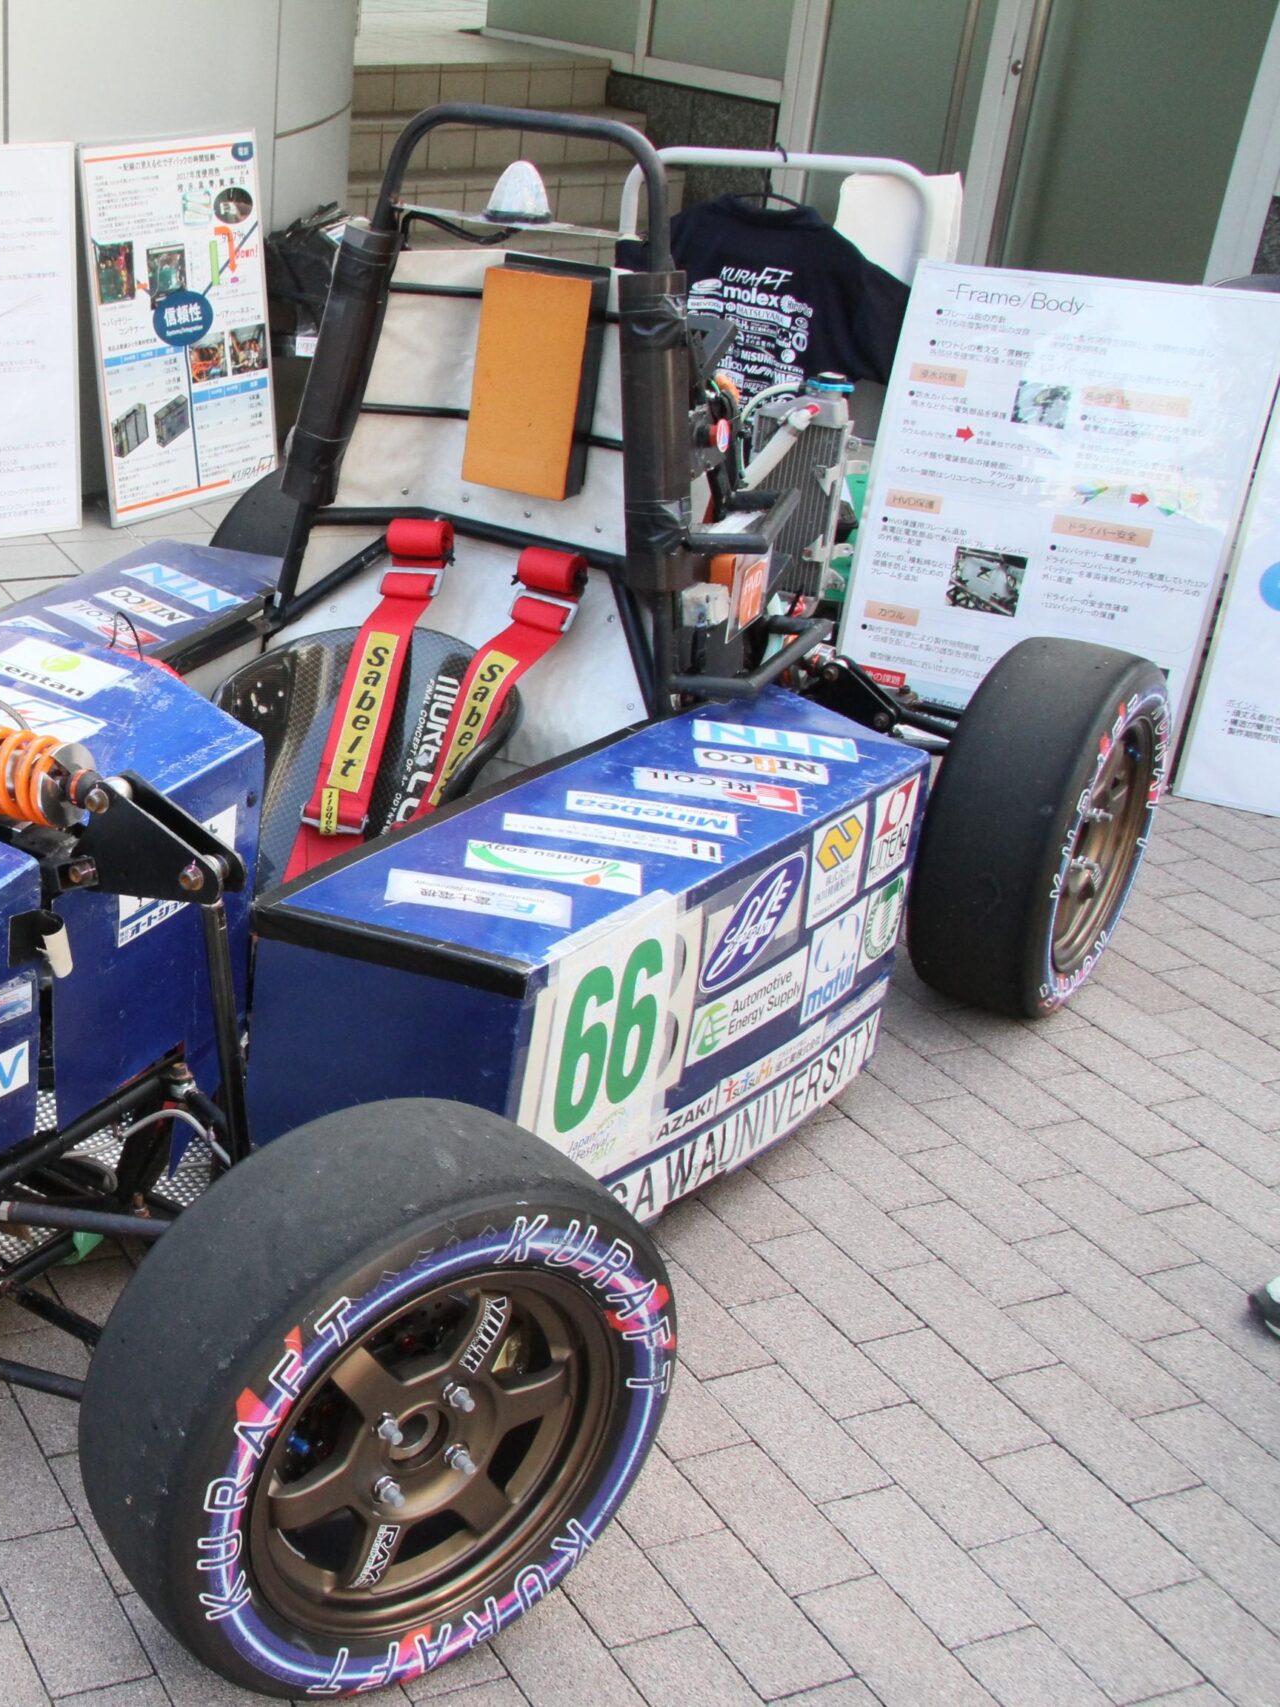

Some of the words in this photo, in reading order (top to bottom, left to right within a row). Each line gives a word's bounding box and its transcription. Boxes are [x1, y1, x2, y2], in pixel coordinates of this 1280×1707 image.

[723, 284, 780, 308] molex
[946, 283, 1095, 316] -Frame/Body-
[164, 304, 203, 327] 信頼性
[1068, 520, 1137, 542] ドライバー安全
[877, 608, 906, 620] カウル
[423, 678, 436, 705] FINAL
[340, 645, 389, 779] Sabelt
[411, 709, 428, 756] CONCEPT
[705, 722, 857, 760] NTN
[405, 757, 414, 773] OF
[645, 770, 752, 793] RECOIL
[576, 797, 729, 832] Minebea
[728, 1005, 765, 1035] Energy
[767, 981, 802, 1011] Supply
[731, 970, 792, 1016] Automotive
[554, 937, 663, 1134] 66
[495, 1213, 671, 1396] KURAFT
[196, 1295, 353, 1622] KURAFT
[307, 1518, 595, 1695] KURAFT
